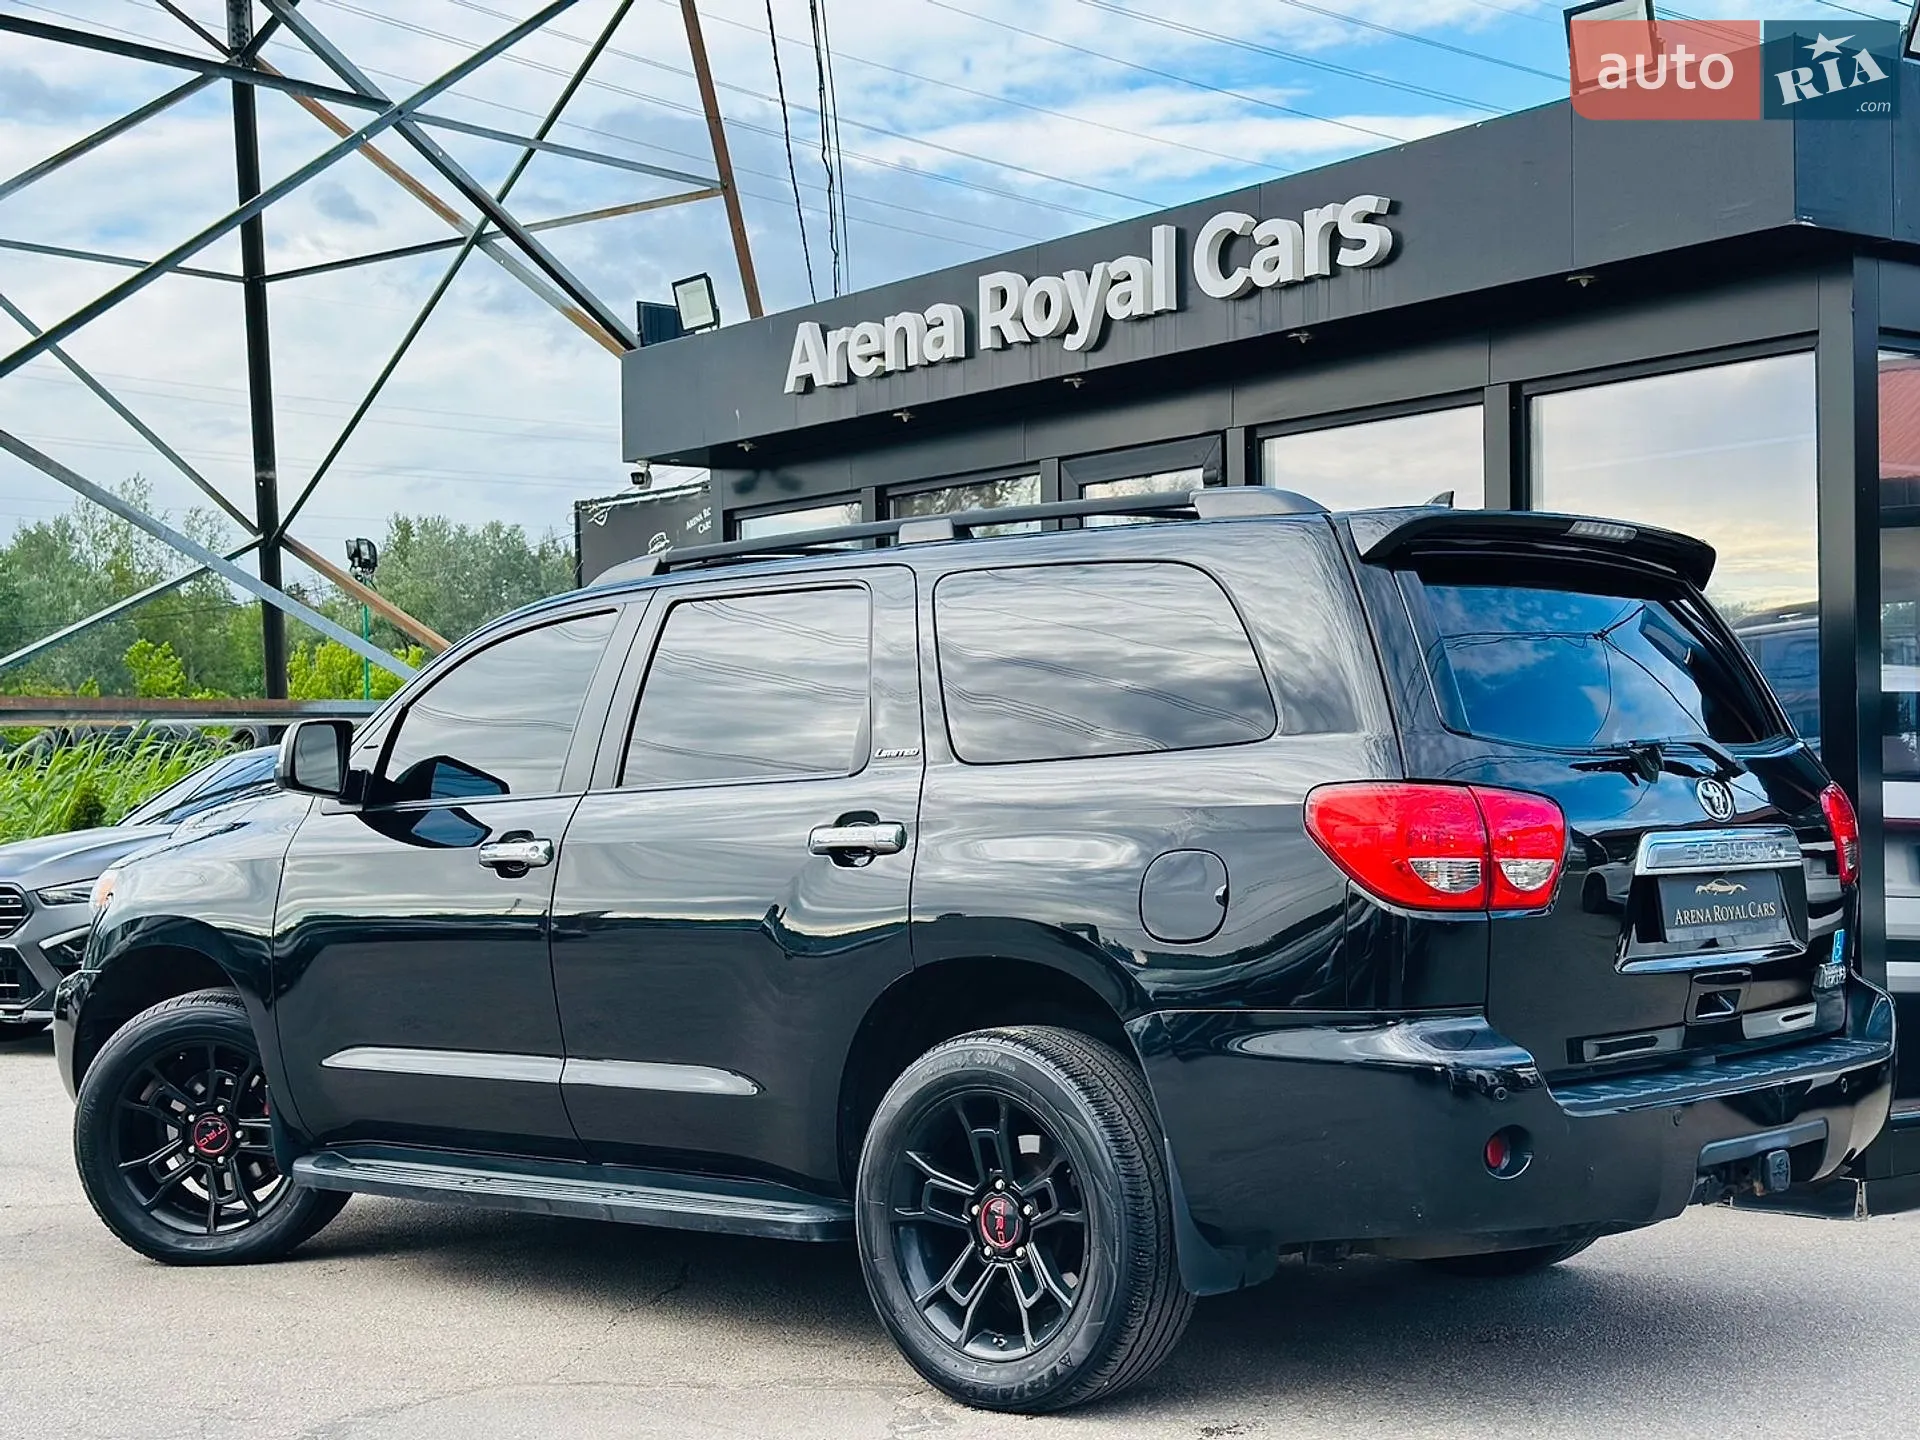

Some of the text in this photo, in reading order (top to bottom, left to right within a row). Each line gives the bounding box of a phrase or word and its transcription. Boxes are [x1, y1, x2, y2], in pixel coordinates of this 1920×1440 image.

[784, 194, 1393, 395] Arena Royal Cars
[1683, 841, 1785, 861] SEQUOIA
[1674, 901, 1776, 926] ARENA ROYAL CARS
